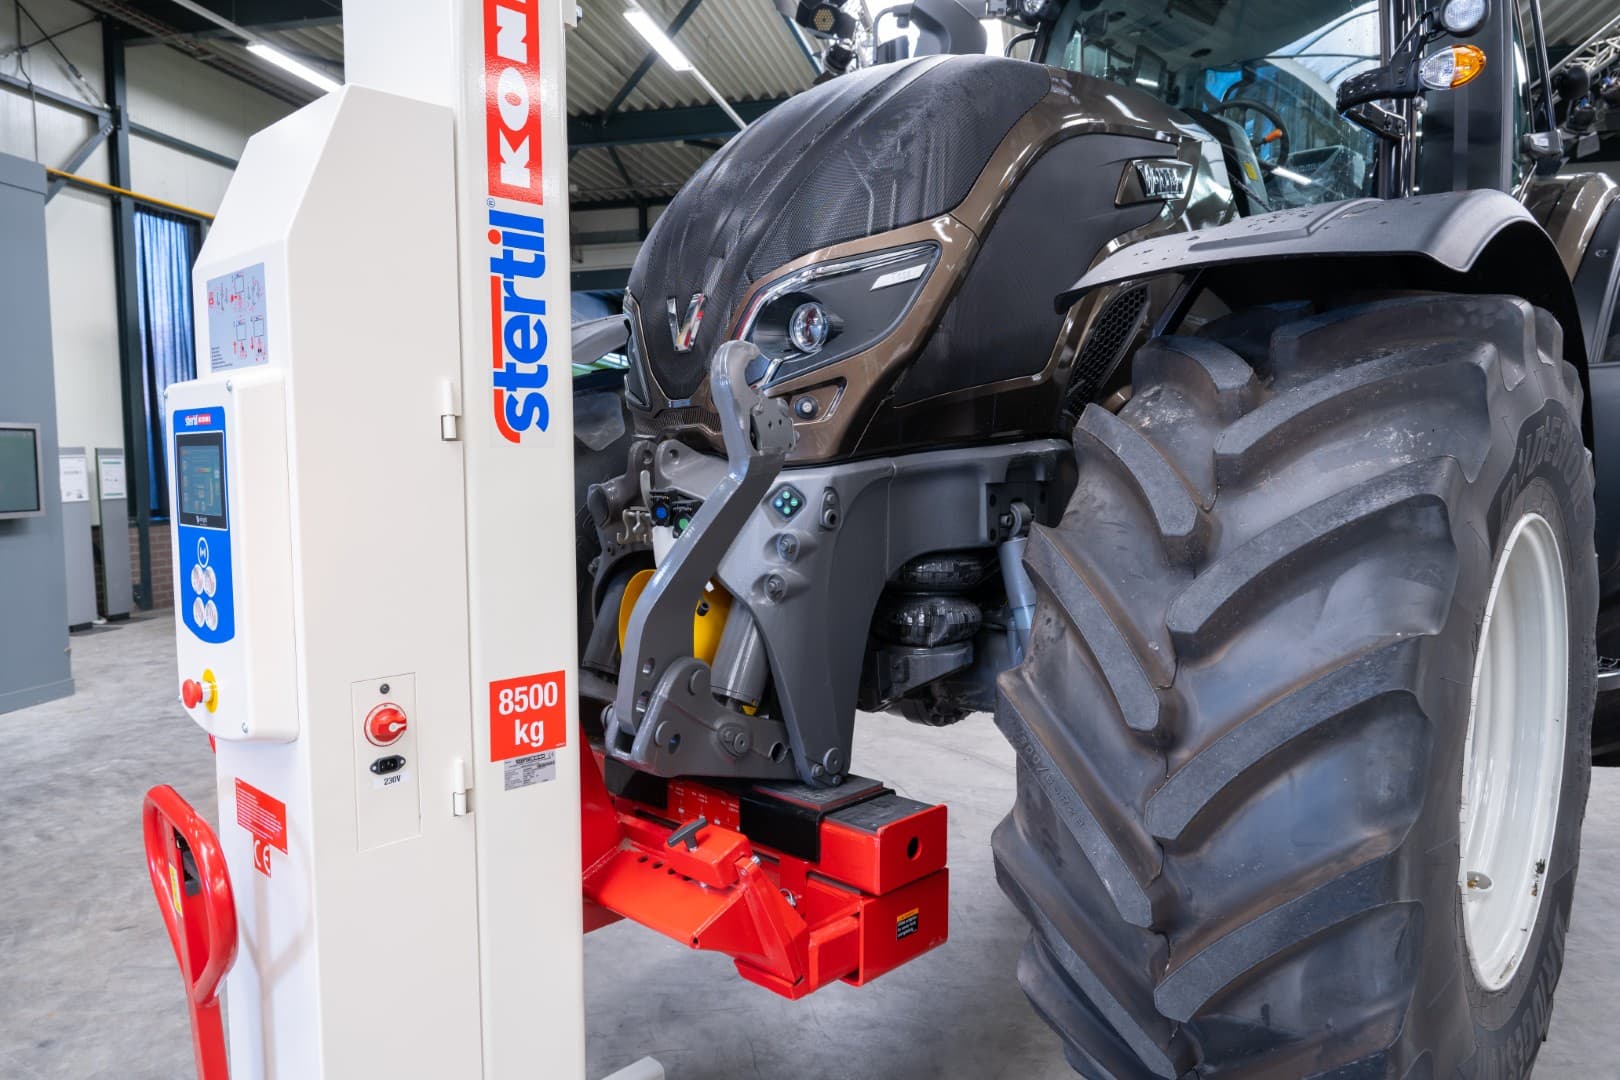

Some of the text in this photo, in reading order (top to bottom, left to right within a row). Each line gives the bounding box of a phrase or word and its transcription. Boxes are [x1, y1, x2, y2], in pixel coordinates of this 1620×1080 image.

[488, 0, 550, 443] stertil KON
[499, 681, 558, 715] 8500
[514, 719, 544, 747] kg
[384, 775, 401, 785] 230V
